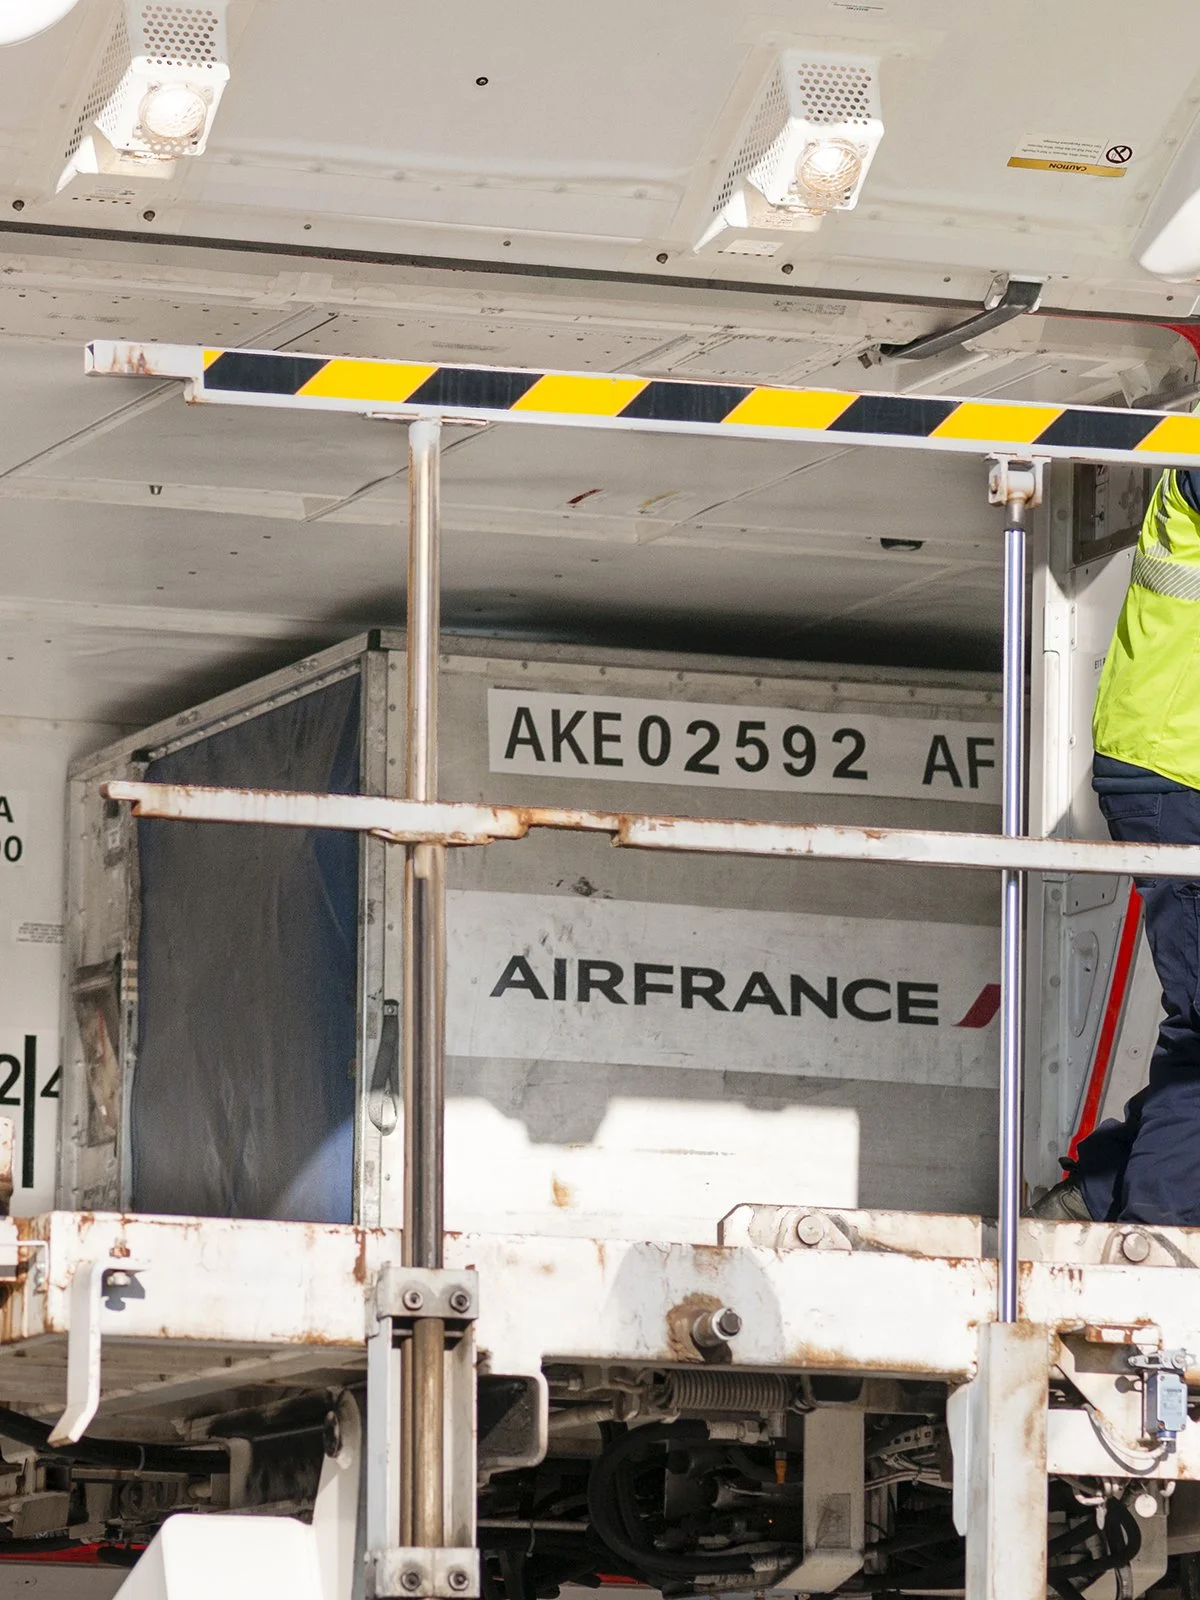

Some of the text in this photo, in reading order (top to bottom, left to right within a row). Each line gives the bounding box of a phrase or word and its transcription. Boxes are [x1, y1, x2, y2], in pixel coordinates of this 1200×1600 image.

[1048, 162, 1087, 171] CAUTION
[922, 734, 995, 789] AF
[0, 835, 22, 863] 0
[489, 955, 939, 1026] AIRFRANCE
